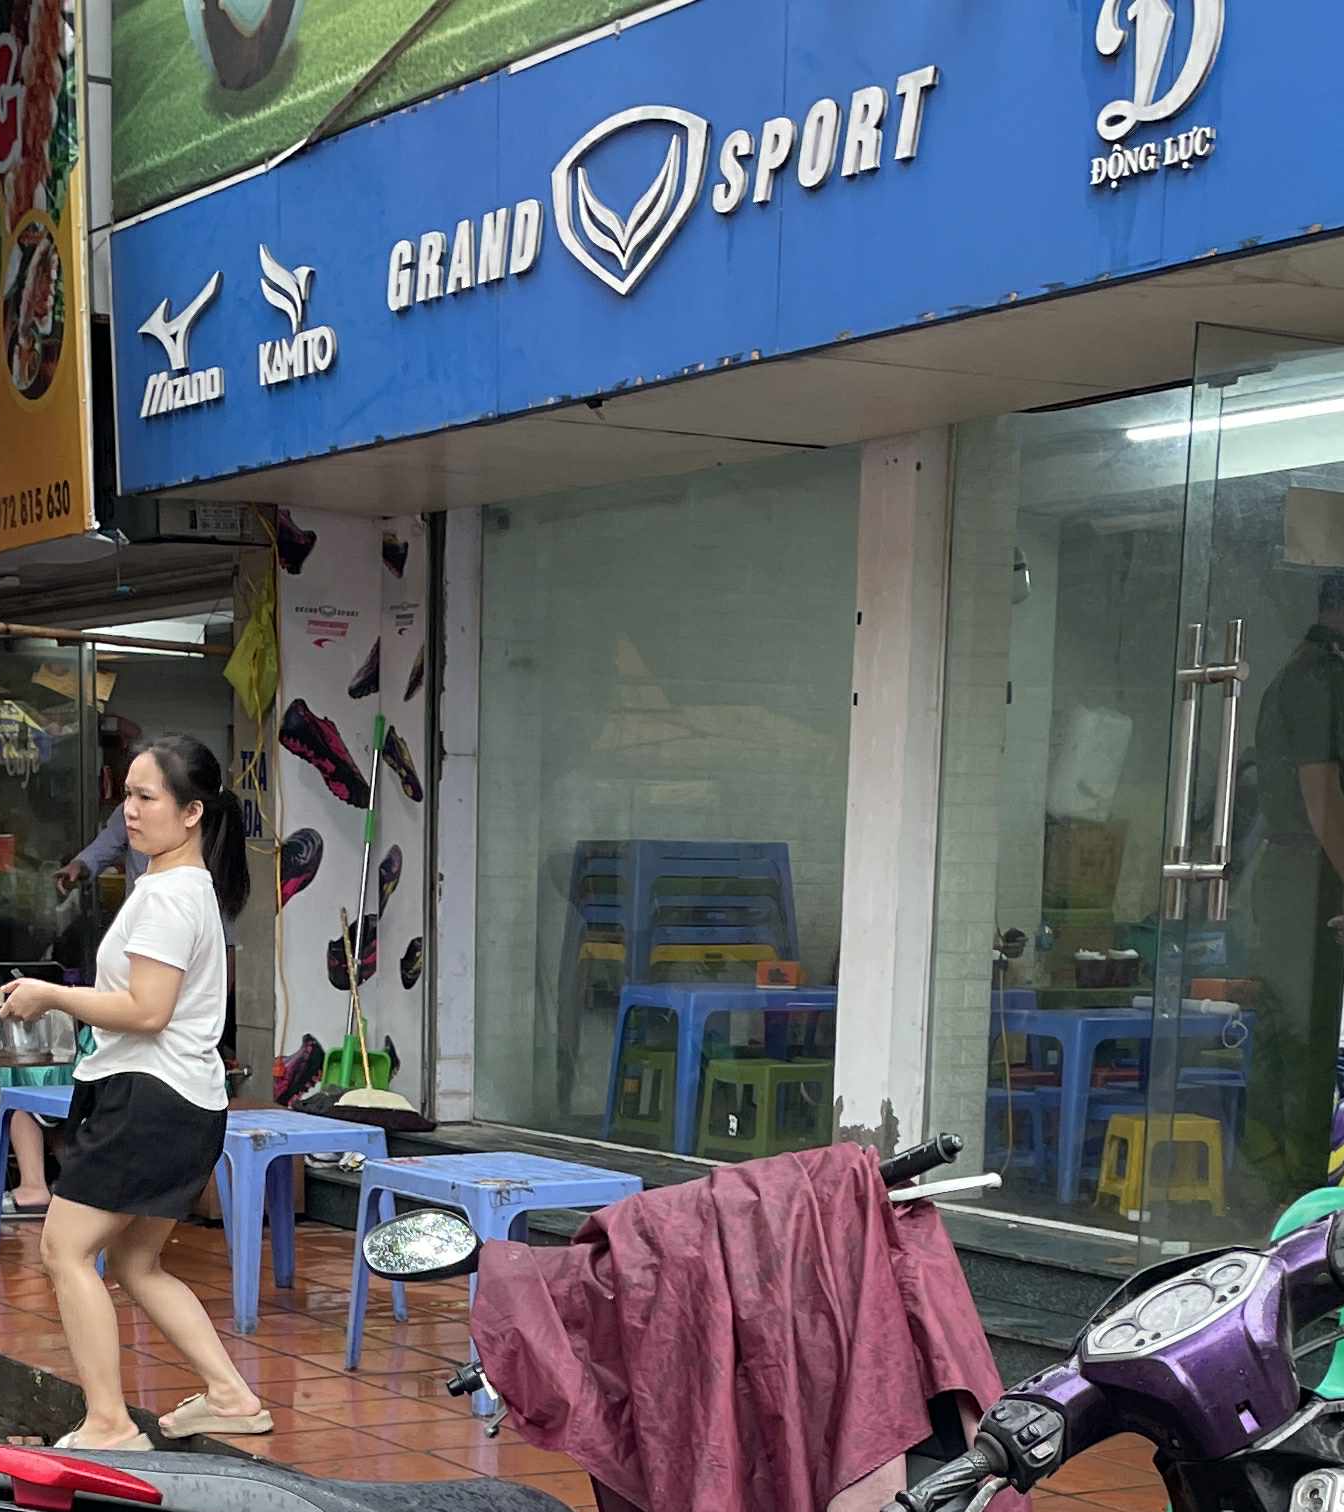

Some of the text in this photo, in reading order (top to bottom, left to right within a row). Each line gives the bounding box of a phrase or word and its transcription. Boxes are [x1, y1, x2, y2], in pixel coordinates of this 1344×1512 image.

[1090, 126, 1216, 189] ĐỘNG LỰC
[387, 65, 939, 313] GRAND SPORT
[259, 326, 336, 386] KAMITO
[47, 479, 71, 519] 630
